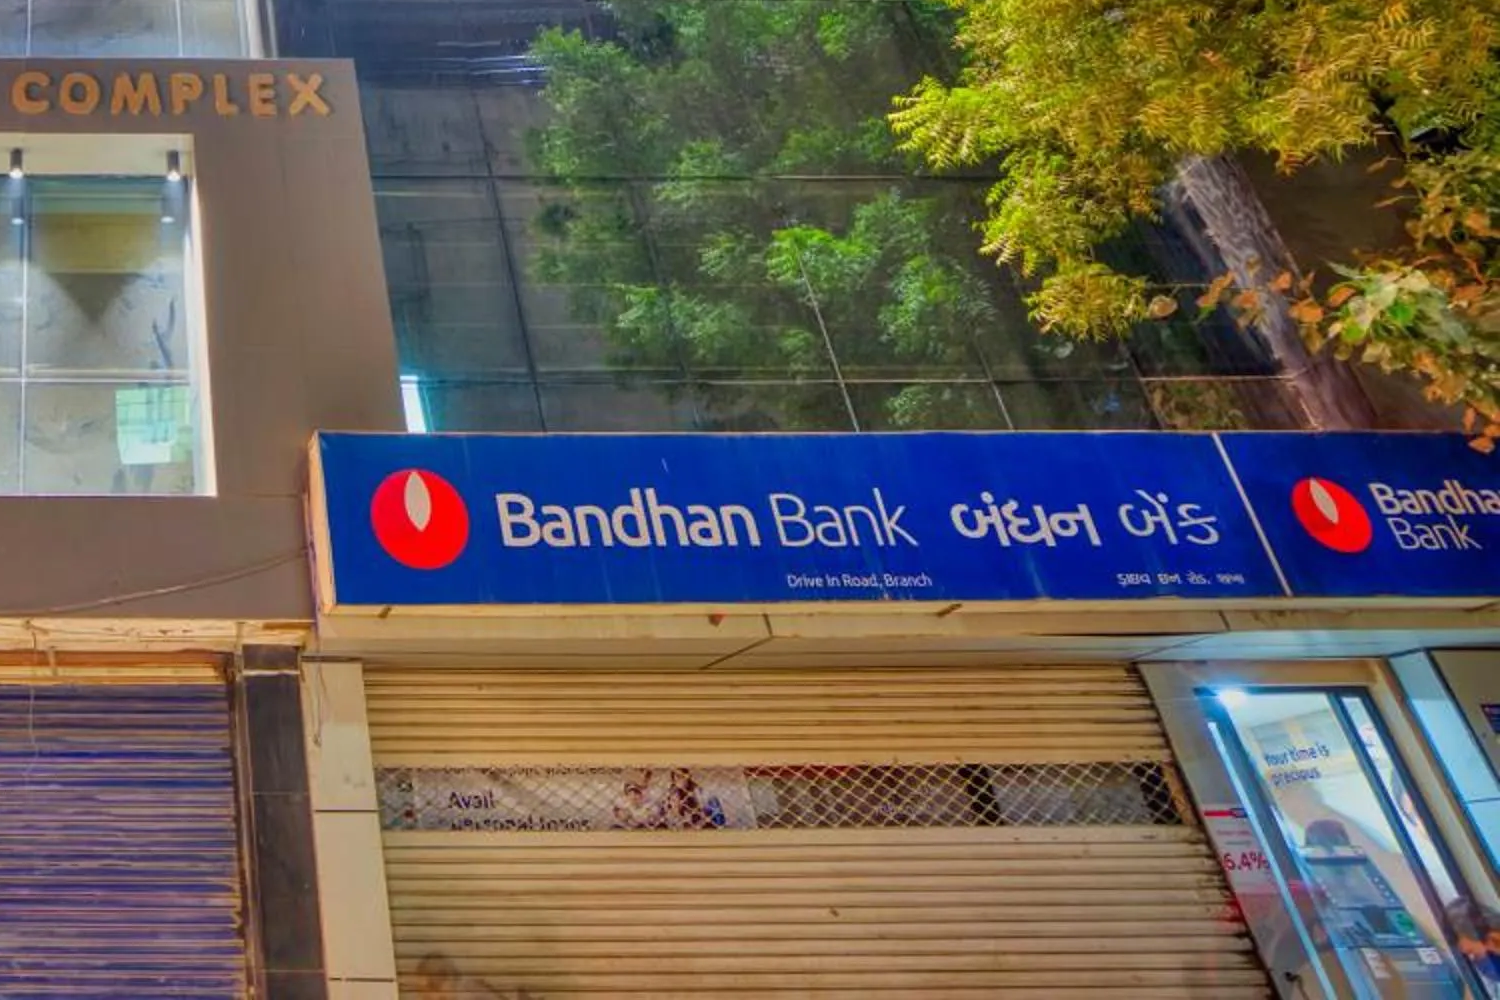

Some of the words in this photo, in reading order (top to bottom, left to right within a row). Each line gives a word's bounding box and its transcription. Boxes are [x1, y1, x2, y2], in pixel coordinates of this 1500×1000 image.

[11, 71, 330, 117] COMPLEX
[1368, 480, 1500, 514] Bandha
[496, 488, 761, 547] Bandhan
[769, 487, 919, 547] Bank
[951, 491, 1102, 547] બંધન
[1387, 513, 1483, 550] Bank
[787, 574, 824, 587] Drive
[884, 572, 933, 587] Branch
[449, 790, 496, 809] Avail
